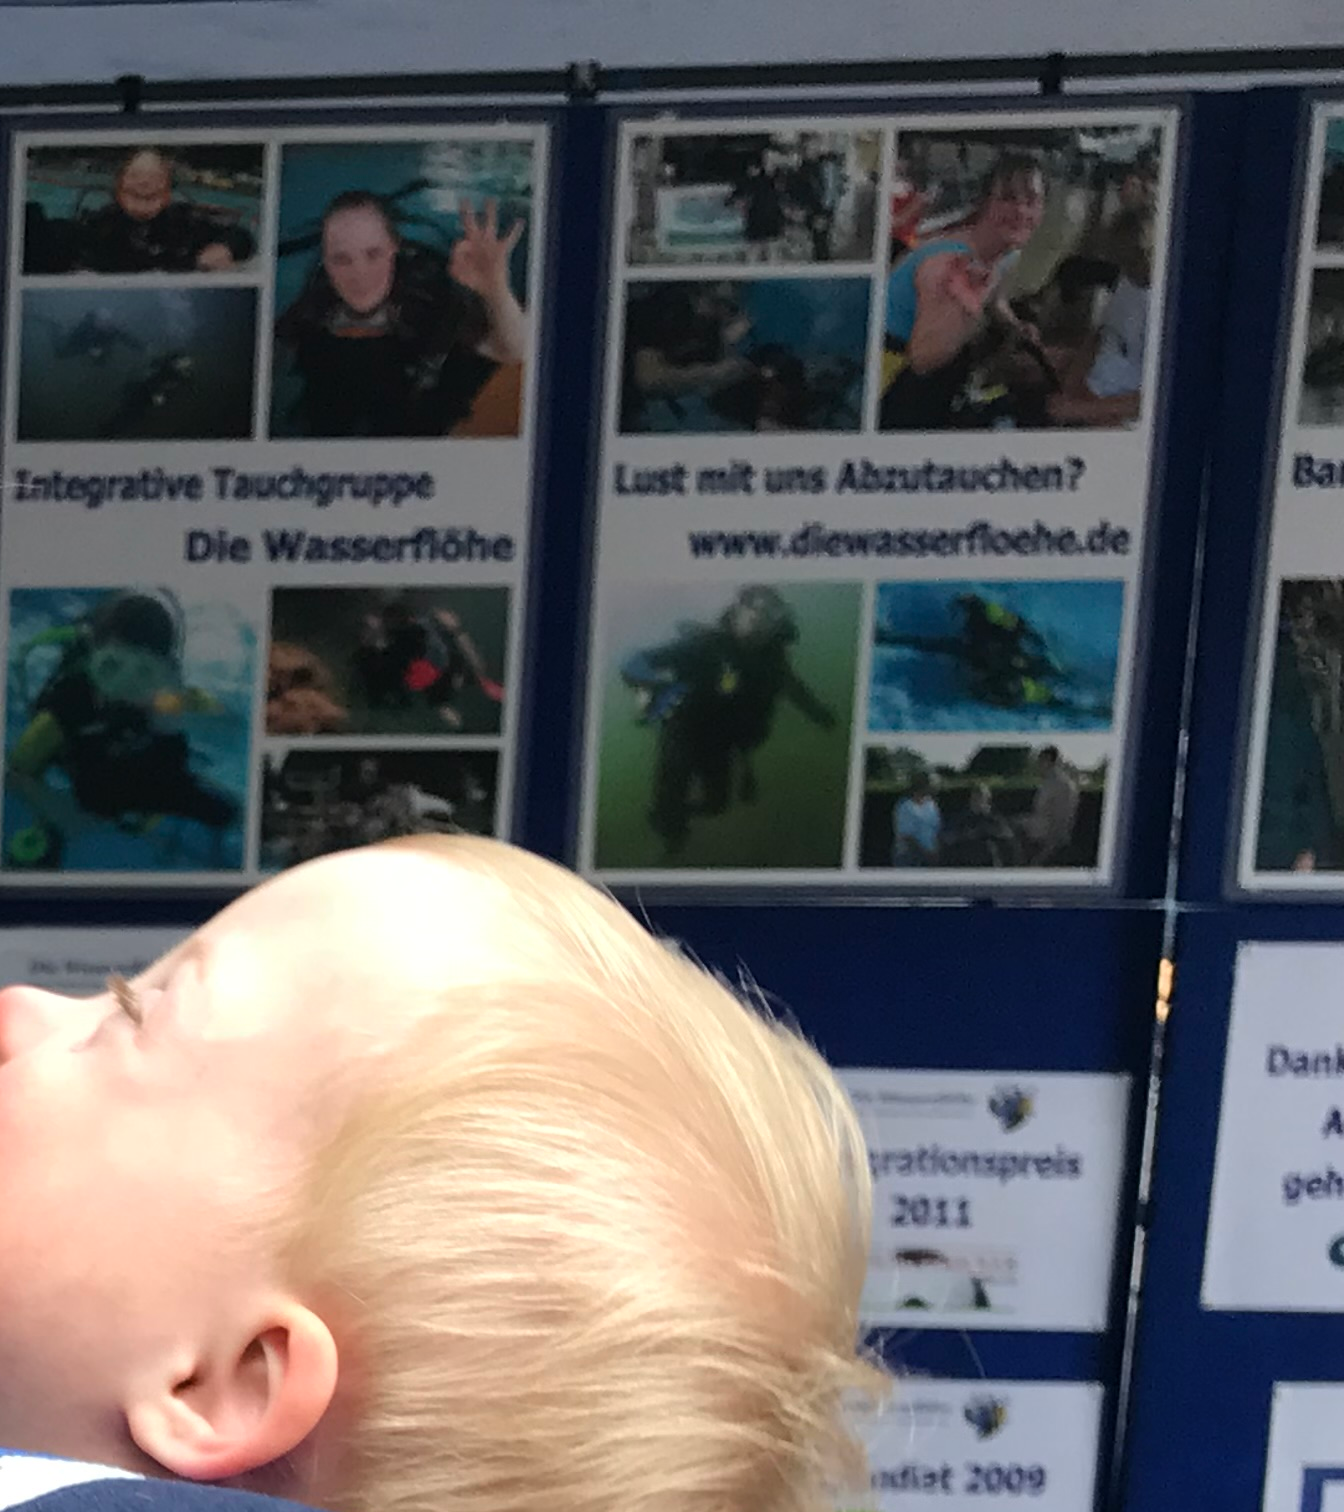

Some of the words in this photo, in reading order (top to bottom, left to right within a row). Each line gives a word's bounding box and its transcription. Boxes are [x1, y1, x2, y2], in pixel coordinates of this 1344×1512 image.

[15, 467, 203, 508] Integrative
[213, 466, 435, 507] Tauchgruppe
[614, 462, 688, 495] Lust
[697, 460, 752, 494] mit
[765, 465, 824, 494] uns
[836, 456, 1085, 494] Abzutauchen?
[186, 529, 250, 563] Die
[263, 527, 514, 564] Wasserflöhe
[690, 521, 1130, 558] www.diewasserfloehe.de
[891, 1195, 971, 1229] 2011
[964, 1463, 1047, 1496] 2009
